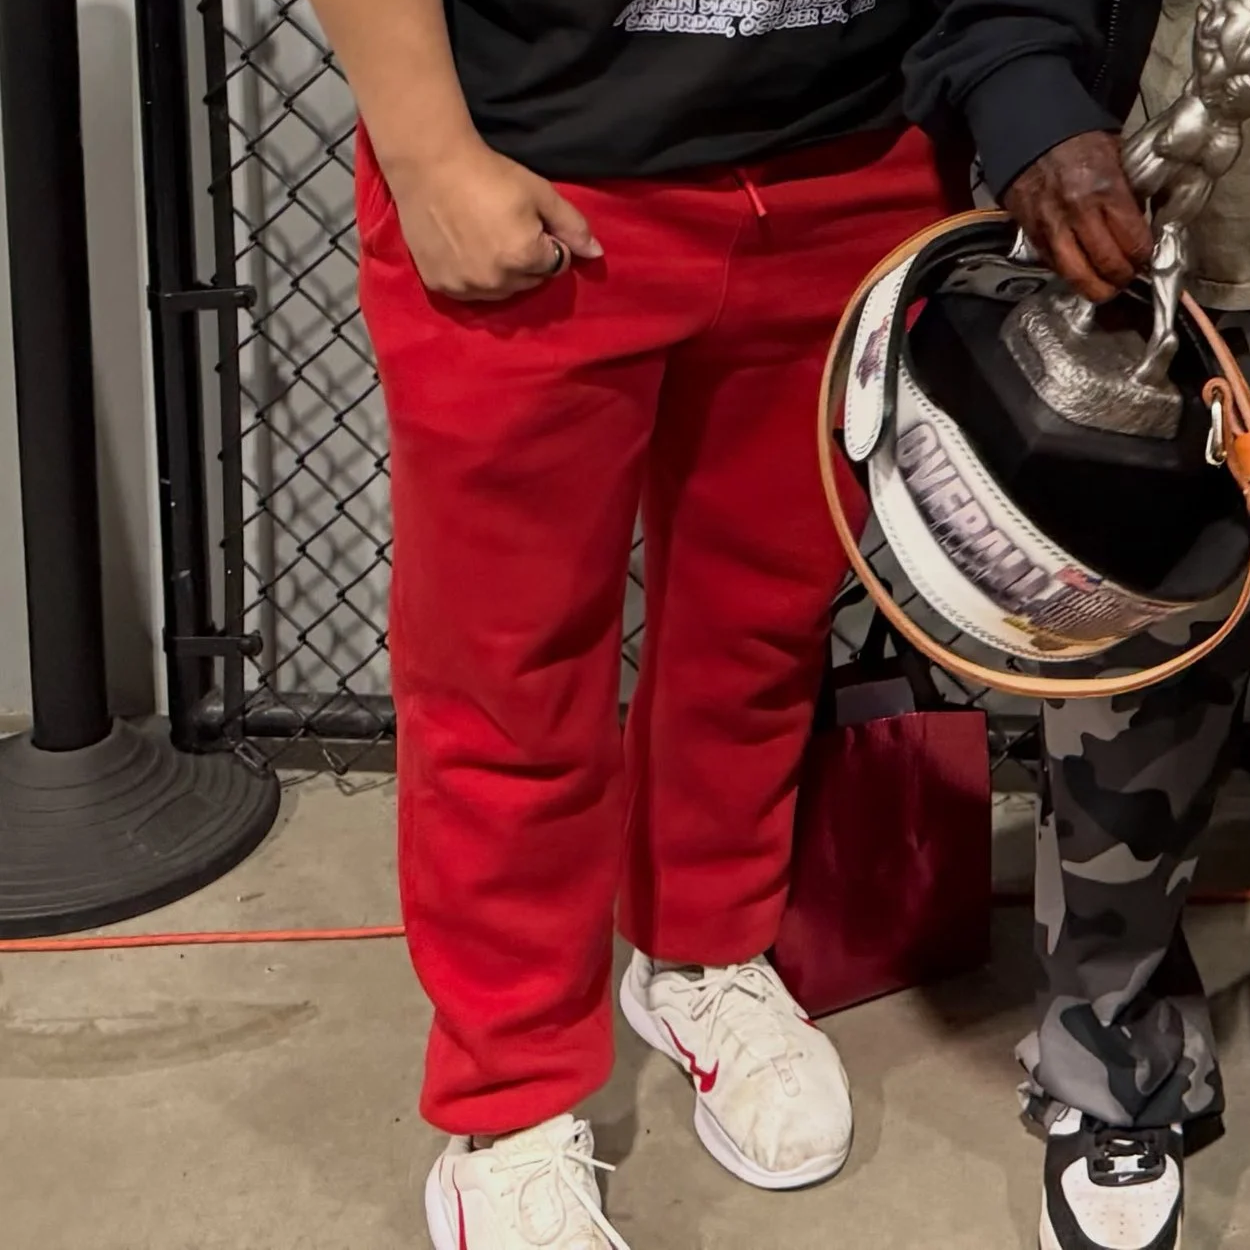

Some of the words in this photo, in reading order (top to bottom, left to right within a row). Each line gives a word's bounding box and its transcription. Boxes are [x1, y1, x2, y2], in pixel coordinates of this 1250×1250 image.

[625, 14, 736, 38] SATURDAY,
[739, 8, 820, 37] OCTOBER
[896, 422, 1052, 605] OVERALL
